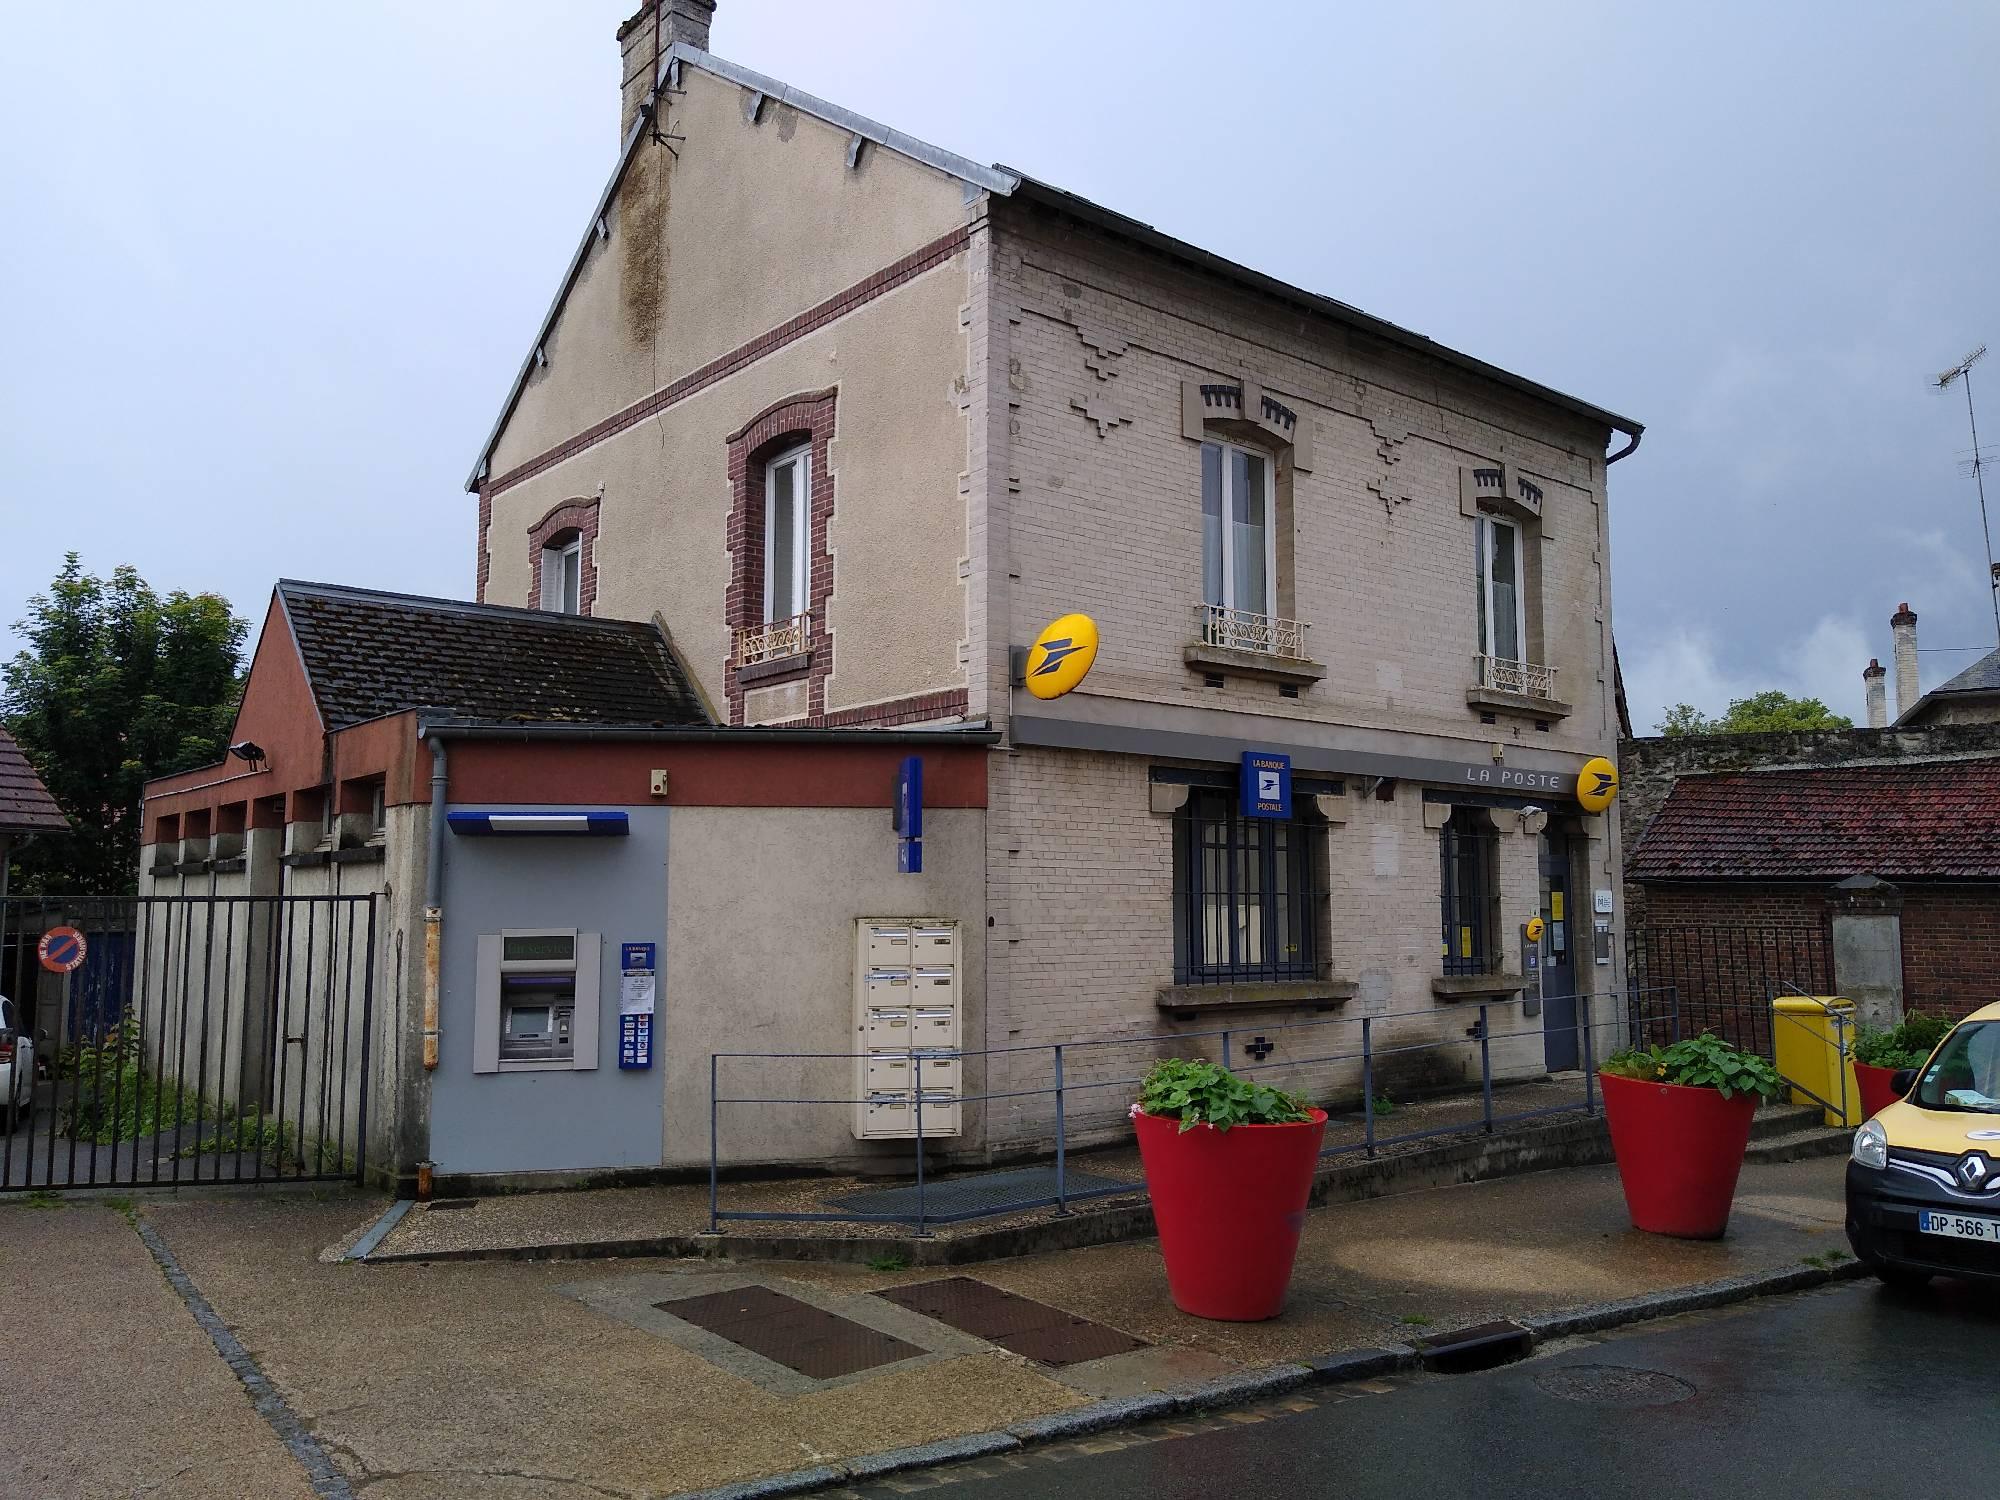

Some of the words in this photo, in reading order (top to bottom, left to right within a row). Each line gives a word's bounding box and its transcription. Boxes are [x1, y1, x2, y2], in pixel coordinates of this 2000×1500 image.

[1253, 759, 1260, 768] LA
[1261, 760, 1285, 770] BANQUE
[1466, 767, 1490, 782] LA
[1501, 771, 1560, 789] POSTE
[1257, 802, 1283, 812] POSTALE
[40, 949, 49, 960] NE
[65, 931, 87, 971] STATIONNER
